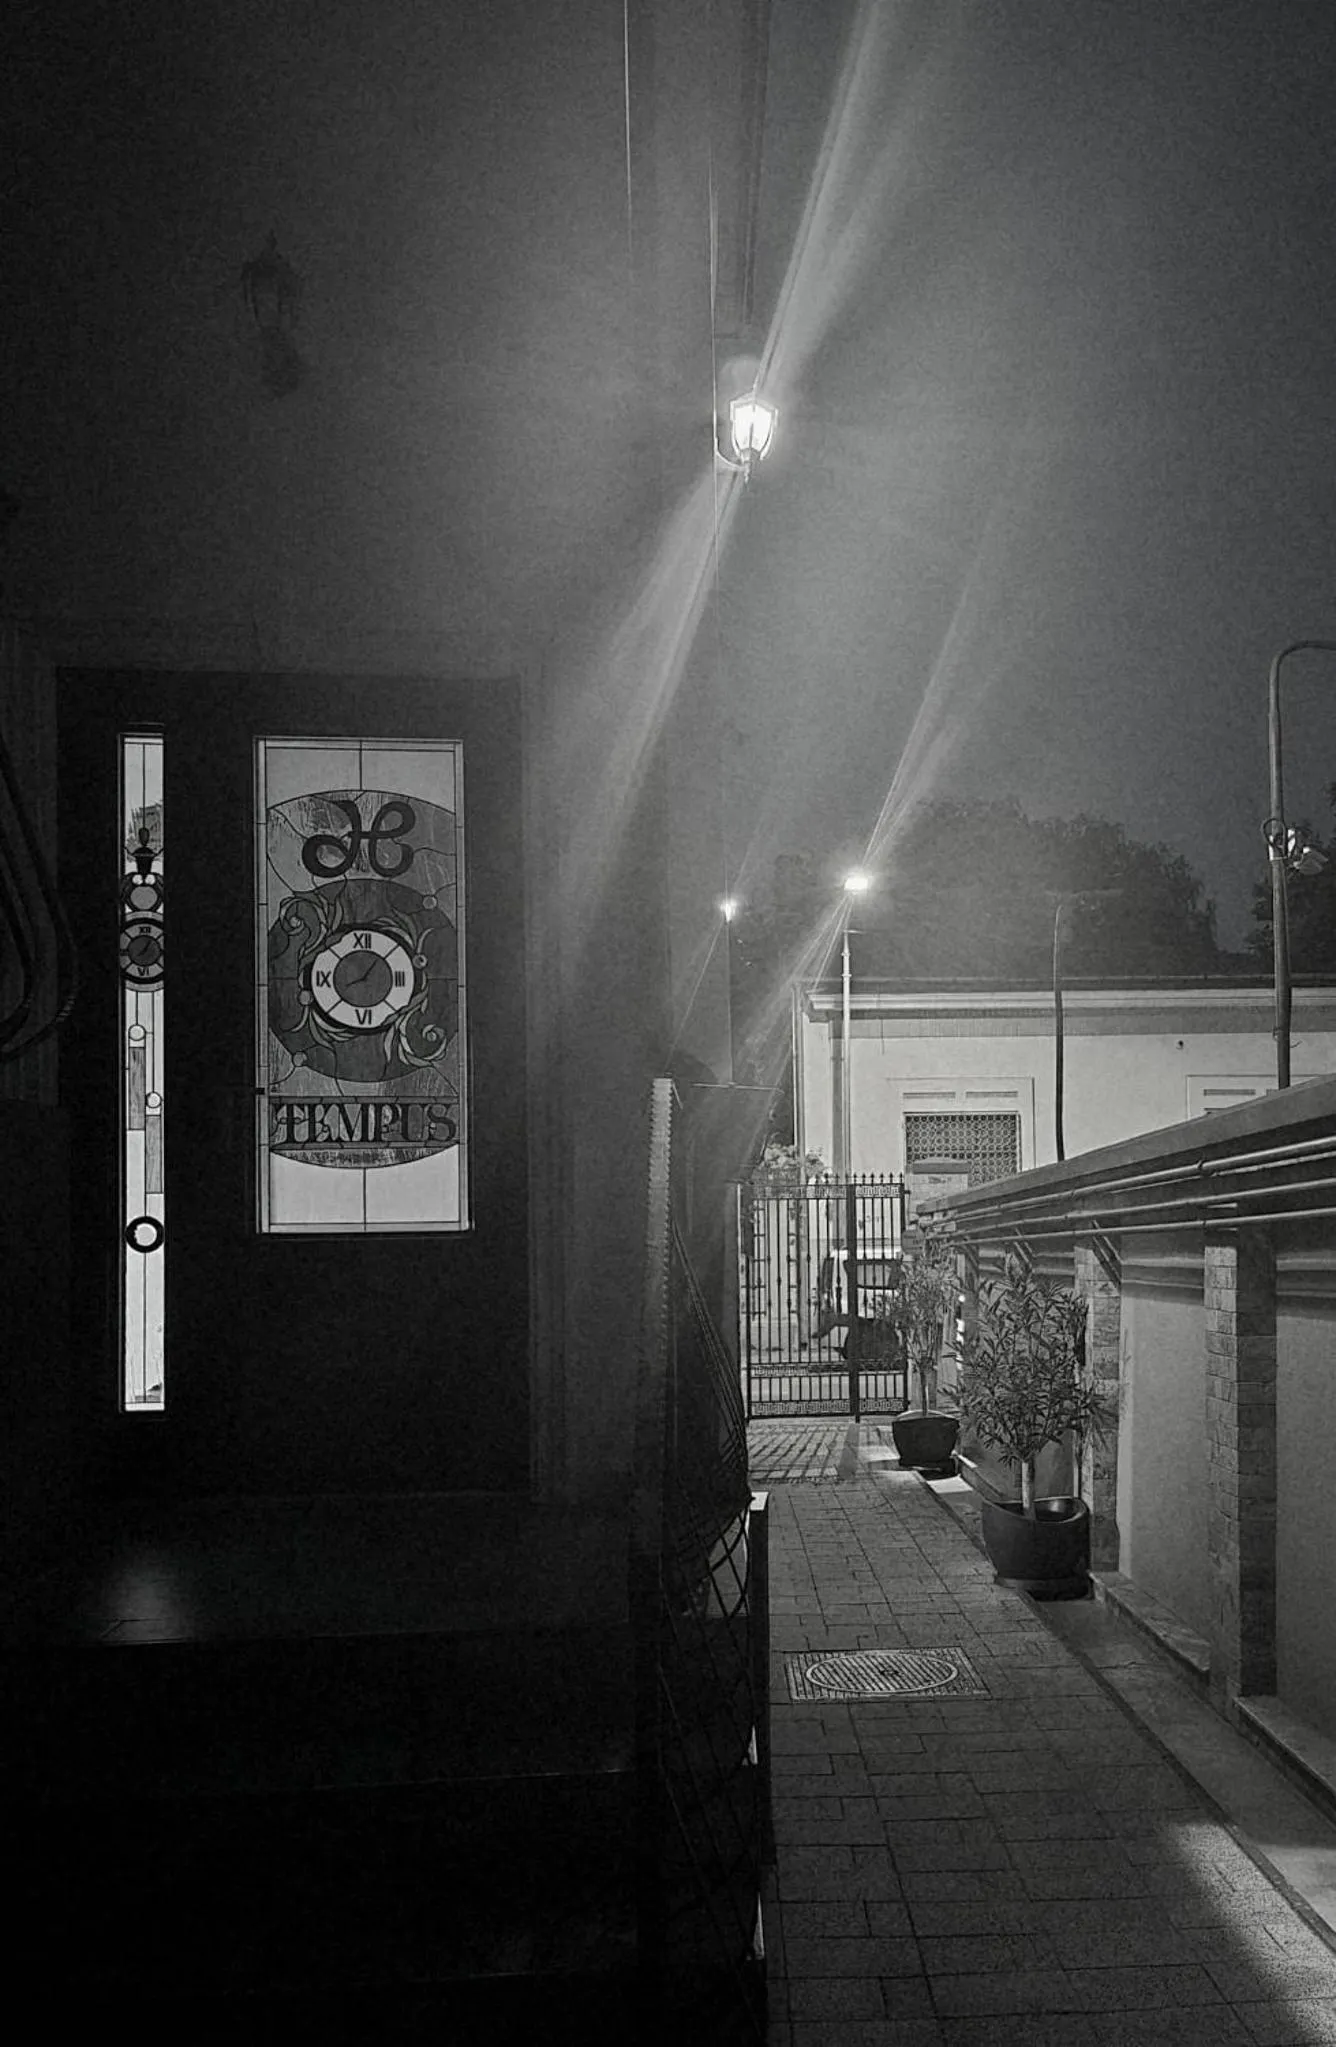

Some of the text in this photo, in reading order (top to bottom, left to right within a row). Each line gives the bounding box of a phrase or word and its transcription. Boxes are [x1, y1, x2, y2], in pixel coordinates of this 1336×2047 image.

[353, 932, 372, 950] XII
[316, 970, 332, 988] IX
[395, 970, 406, 988] III
[355, 1008, 373, 1025] VI
[271, 1102, 458, 1144] TEMPUS
